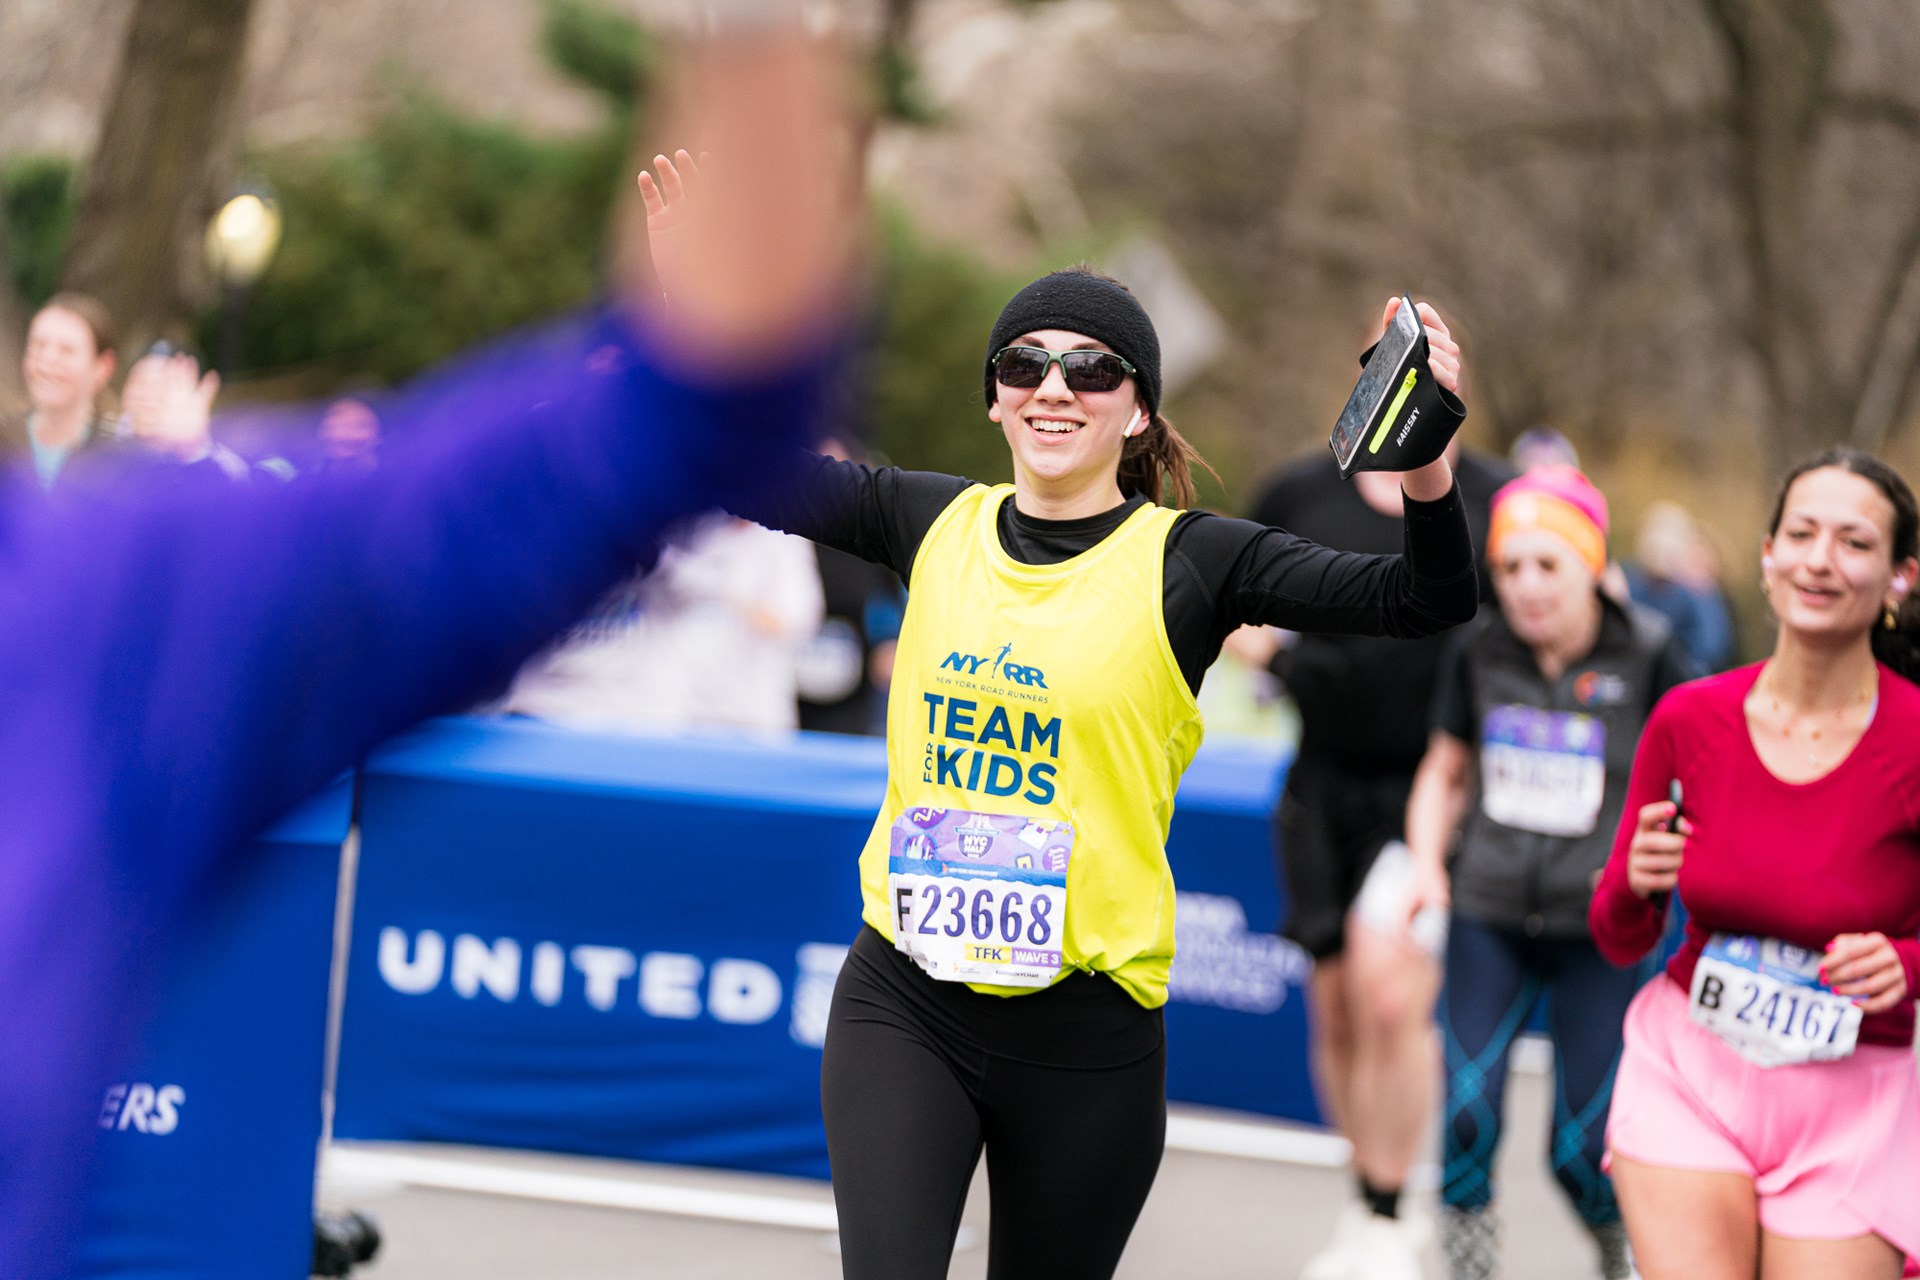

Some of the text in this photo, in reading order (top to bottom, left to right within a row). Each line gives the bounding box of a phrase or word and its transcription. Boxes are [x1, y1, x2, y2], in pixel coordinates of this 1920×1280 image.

[936, 676, 1049, 704] NEW YORK ROAD RUNNERS
[923, 692, 1062, 759] TEAM
[923, 742, 933, 784] FOR
[936, 744, 1058, 806] KIDS
[963, 834, 989, 847] NYC
[896, 884, 1053, 946] F 23668
[377, 926, 783, 1025] UNITED
[974, 947, 1002, 961] TFK
[1014, 950, 1059, 965] WAVE 3
[1698, 974, 1725, 1010] B
[1736, 982, 1846, 1044] 24167
